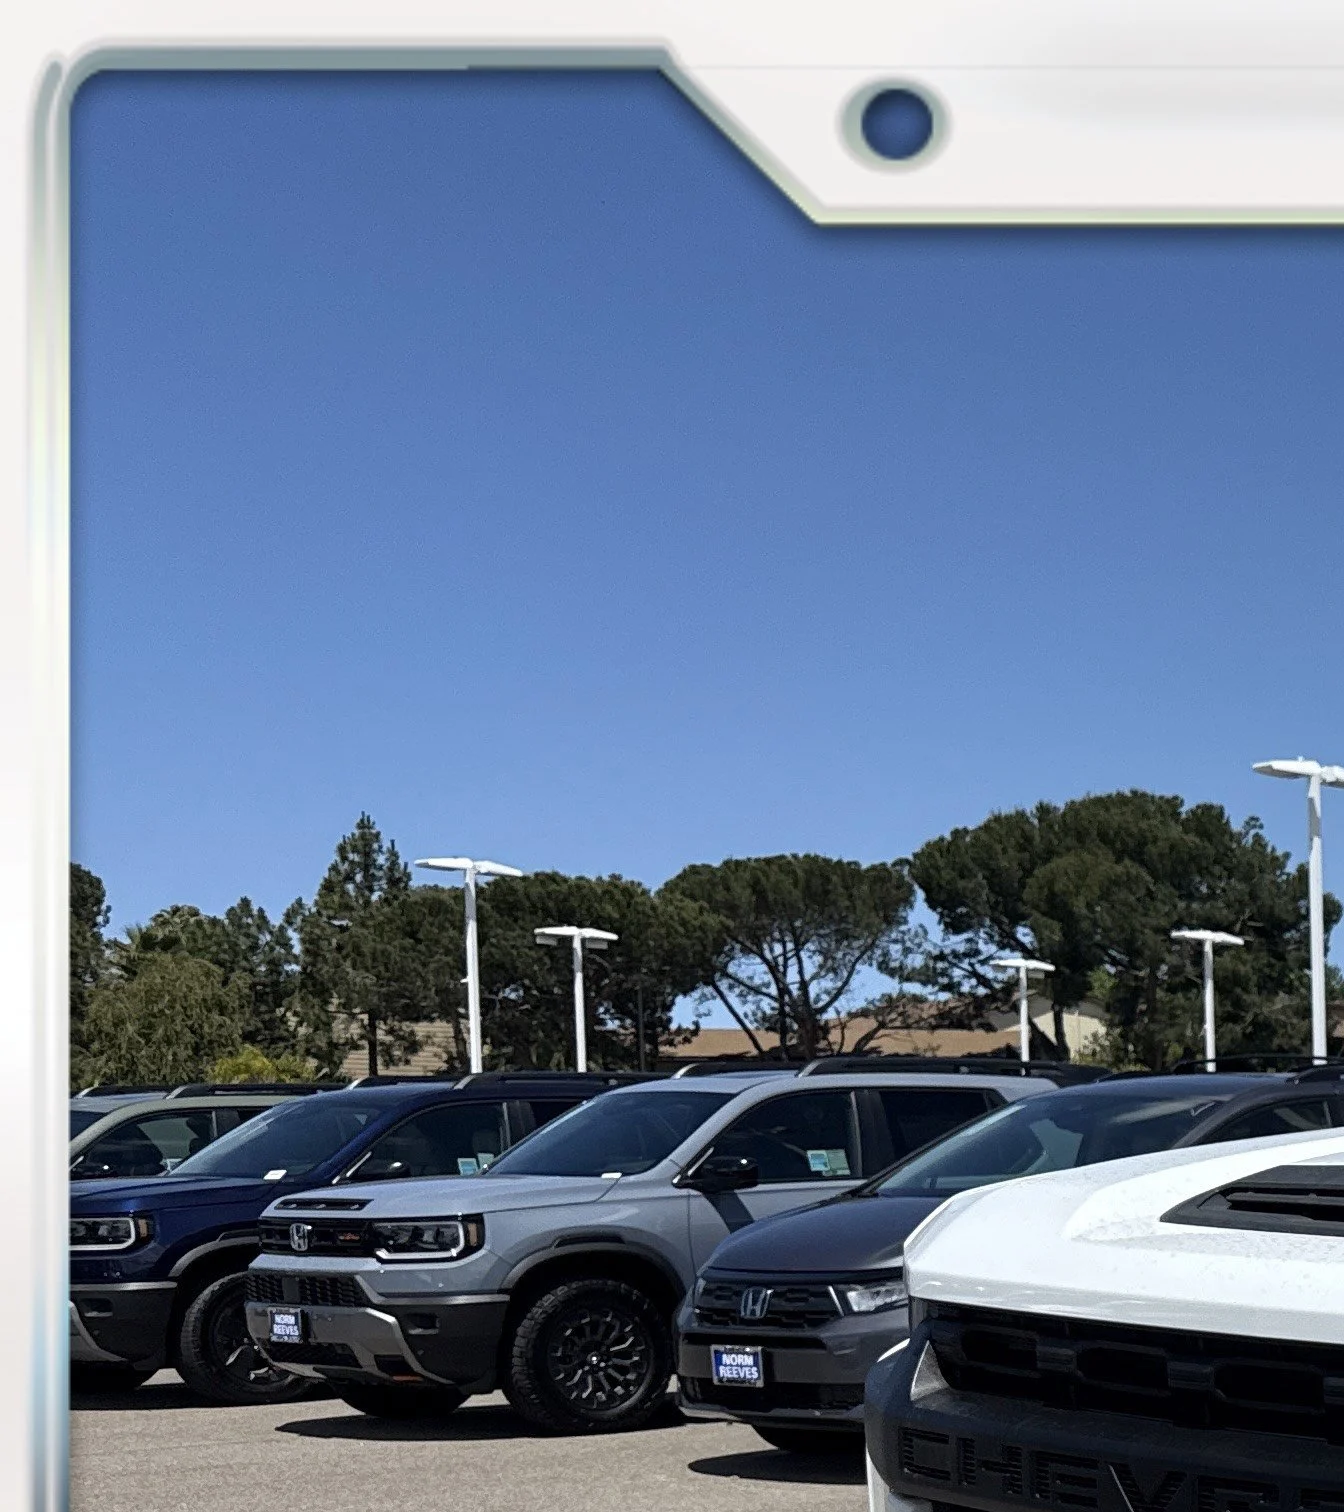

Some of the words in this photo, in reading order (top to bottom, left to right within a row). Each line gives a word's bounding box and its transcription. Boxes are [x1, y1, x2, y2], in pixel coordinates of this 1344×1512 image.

[272, 1323, 300, 1336] REEVES
[721, 1353, 754, 1366] NORM
[718, 1365, 759, 1379] REEVES
